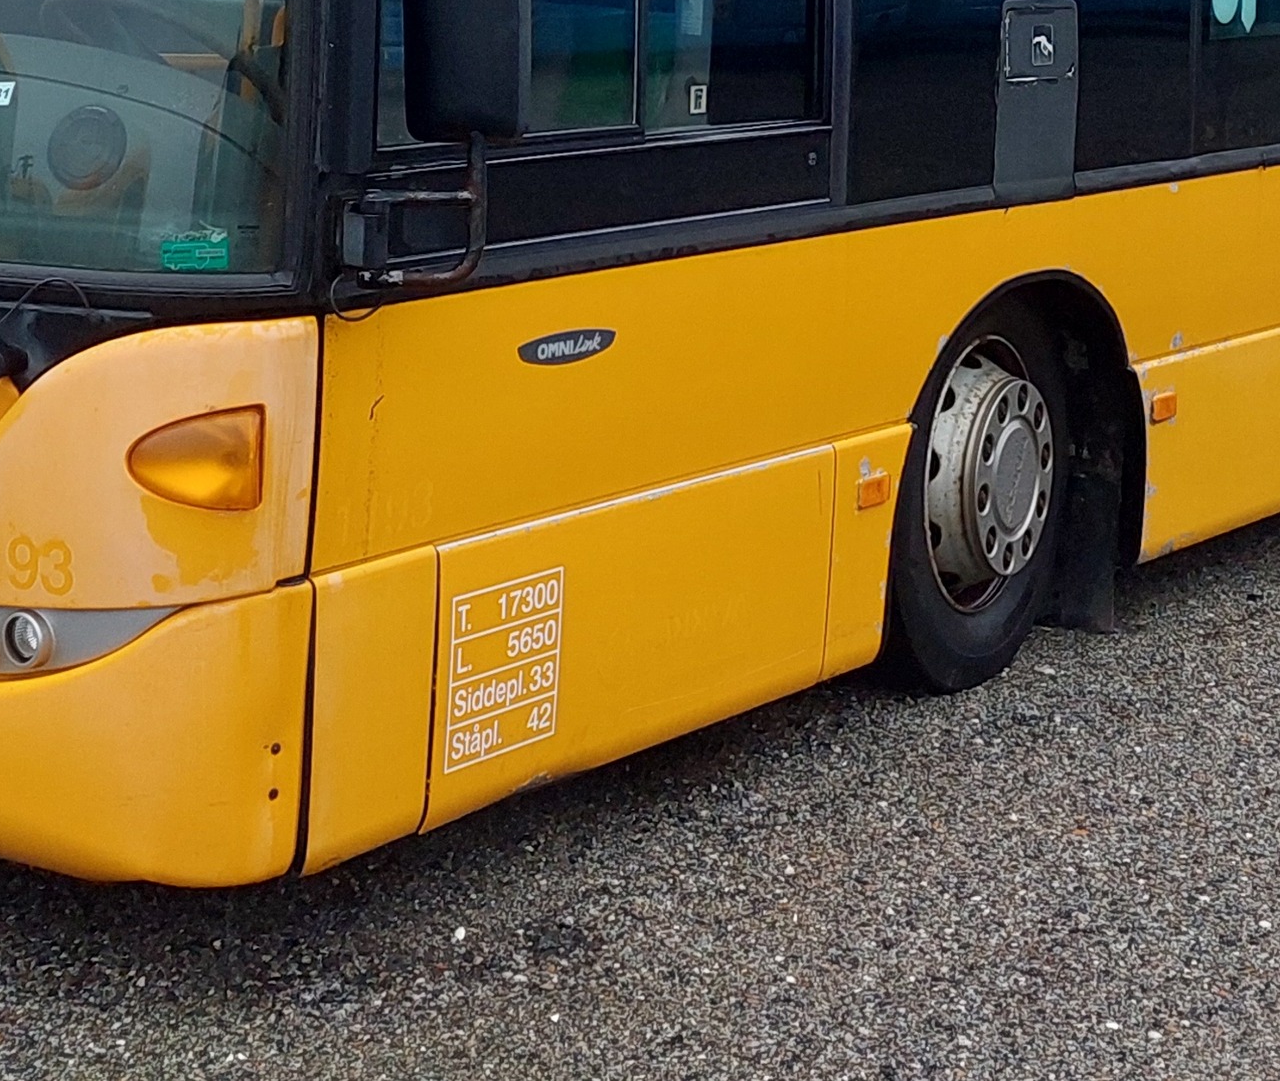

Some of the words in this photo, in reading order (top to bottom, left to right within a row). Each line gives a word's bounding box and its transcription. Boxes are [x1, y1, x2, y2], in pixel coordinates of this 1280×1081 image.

[458, 604, 472, 632] T.
[498, 579, 559, 620] 17300
[456, 647, 472, 674] L.
[507, 619, 556, 657] 5650
[453, 670, 527, 717] Siddepl.
[529, 661, 554, 691] 33
[451, 720, 503, 760] Ståpl.
[527, 702, 552, 731] 42
